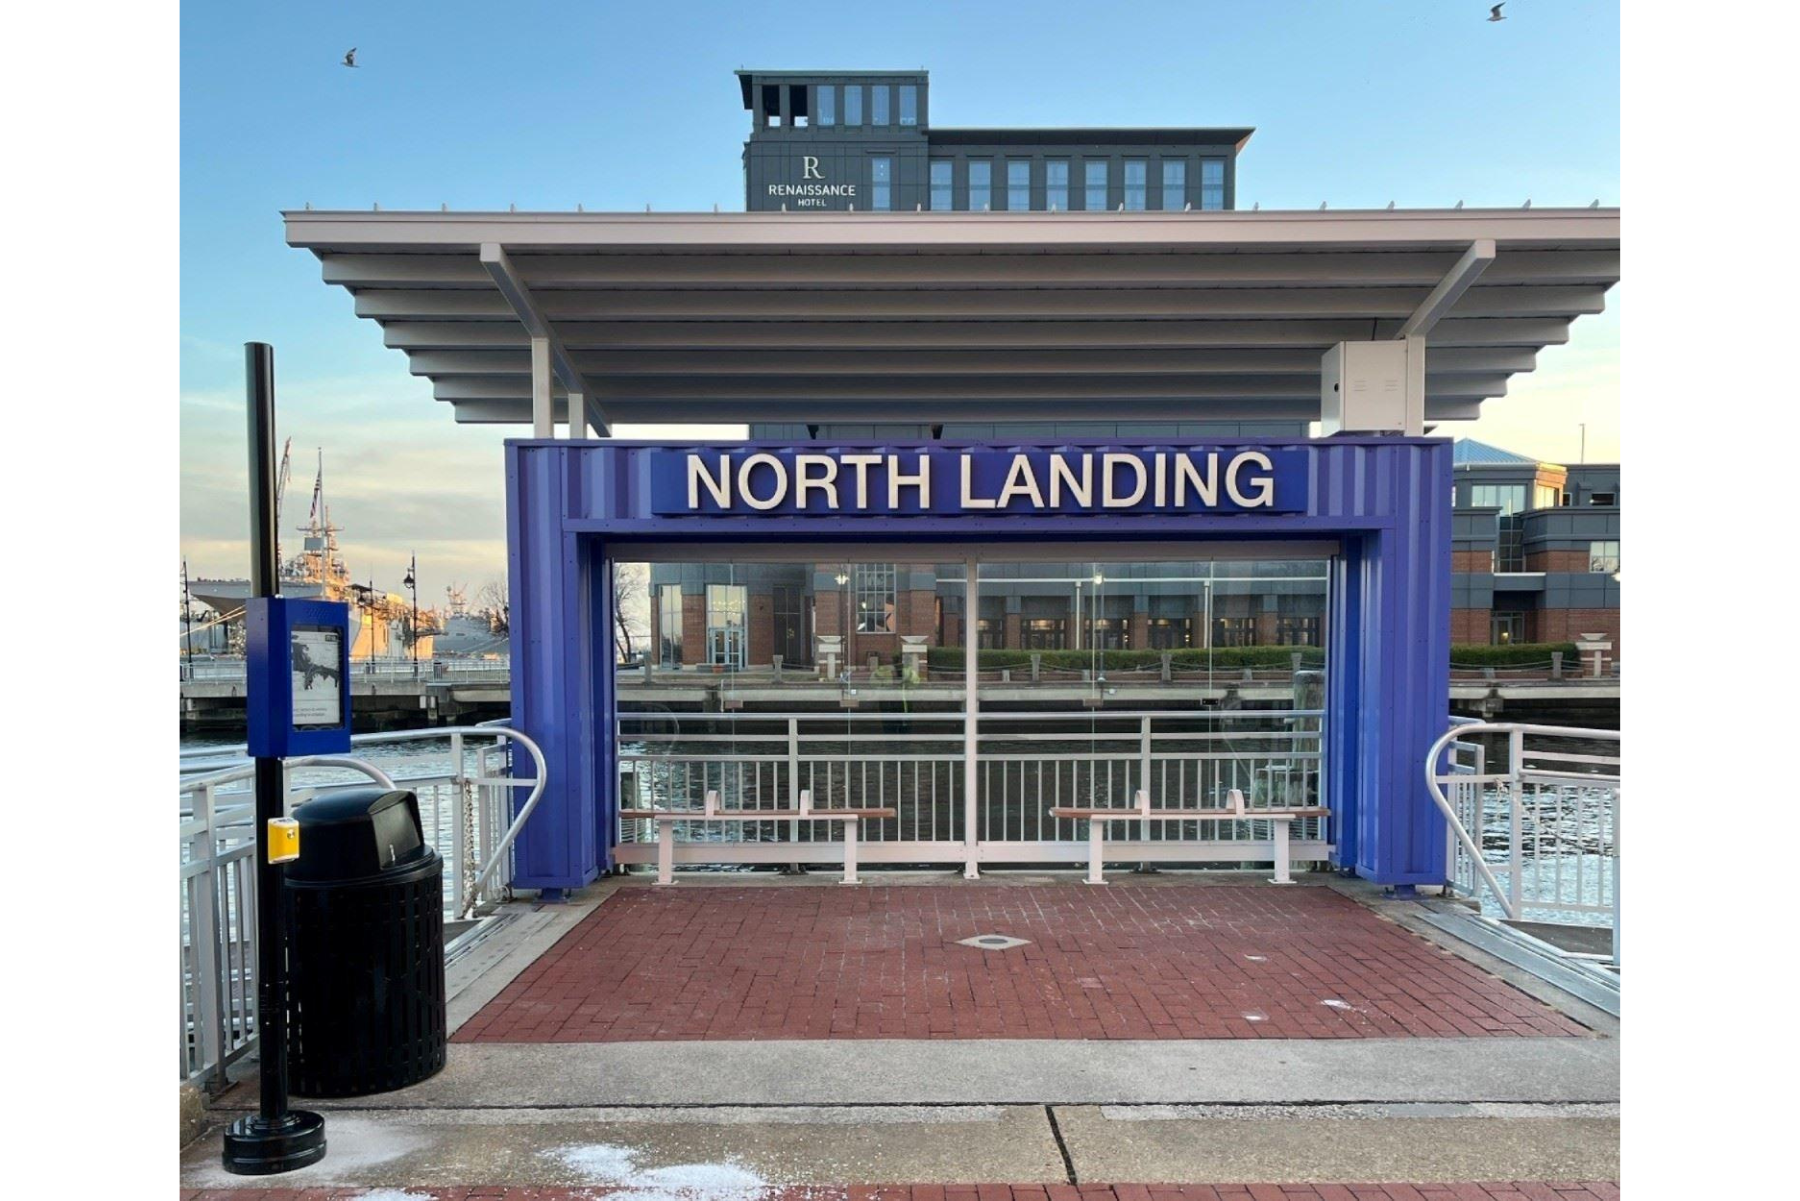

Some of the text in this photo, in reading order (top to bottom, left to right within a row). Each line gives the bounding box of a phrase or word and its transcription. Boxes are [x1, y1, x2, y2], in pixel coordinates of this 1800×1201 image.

[802, 156, 826, 179] R
[768, 184, 857, 196] RENAISSANCE
[797, 198, 827, 207] HOTEL
[686, 451, 1275, 511] NORTH LANDING
